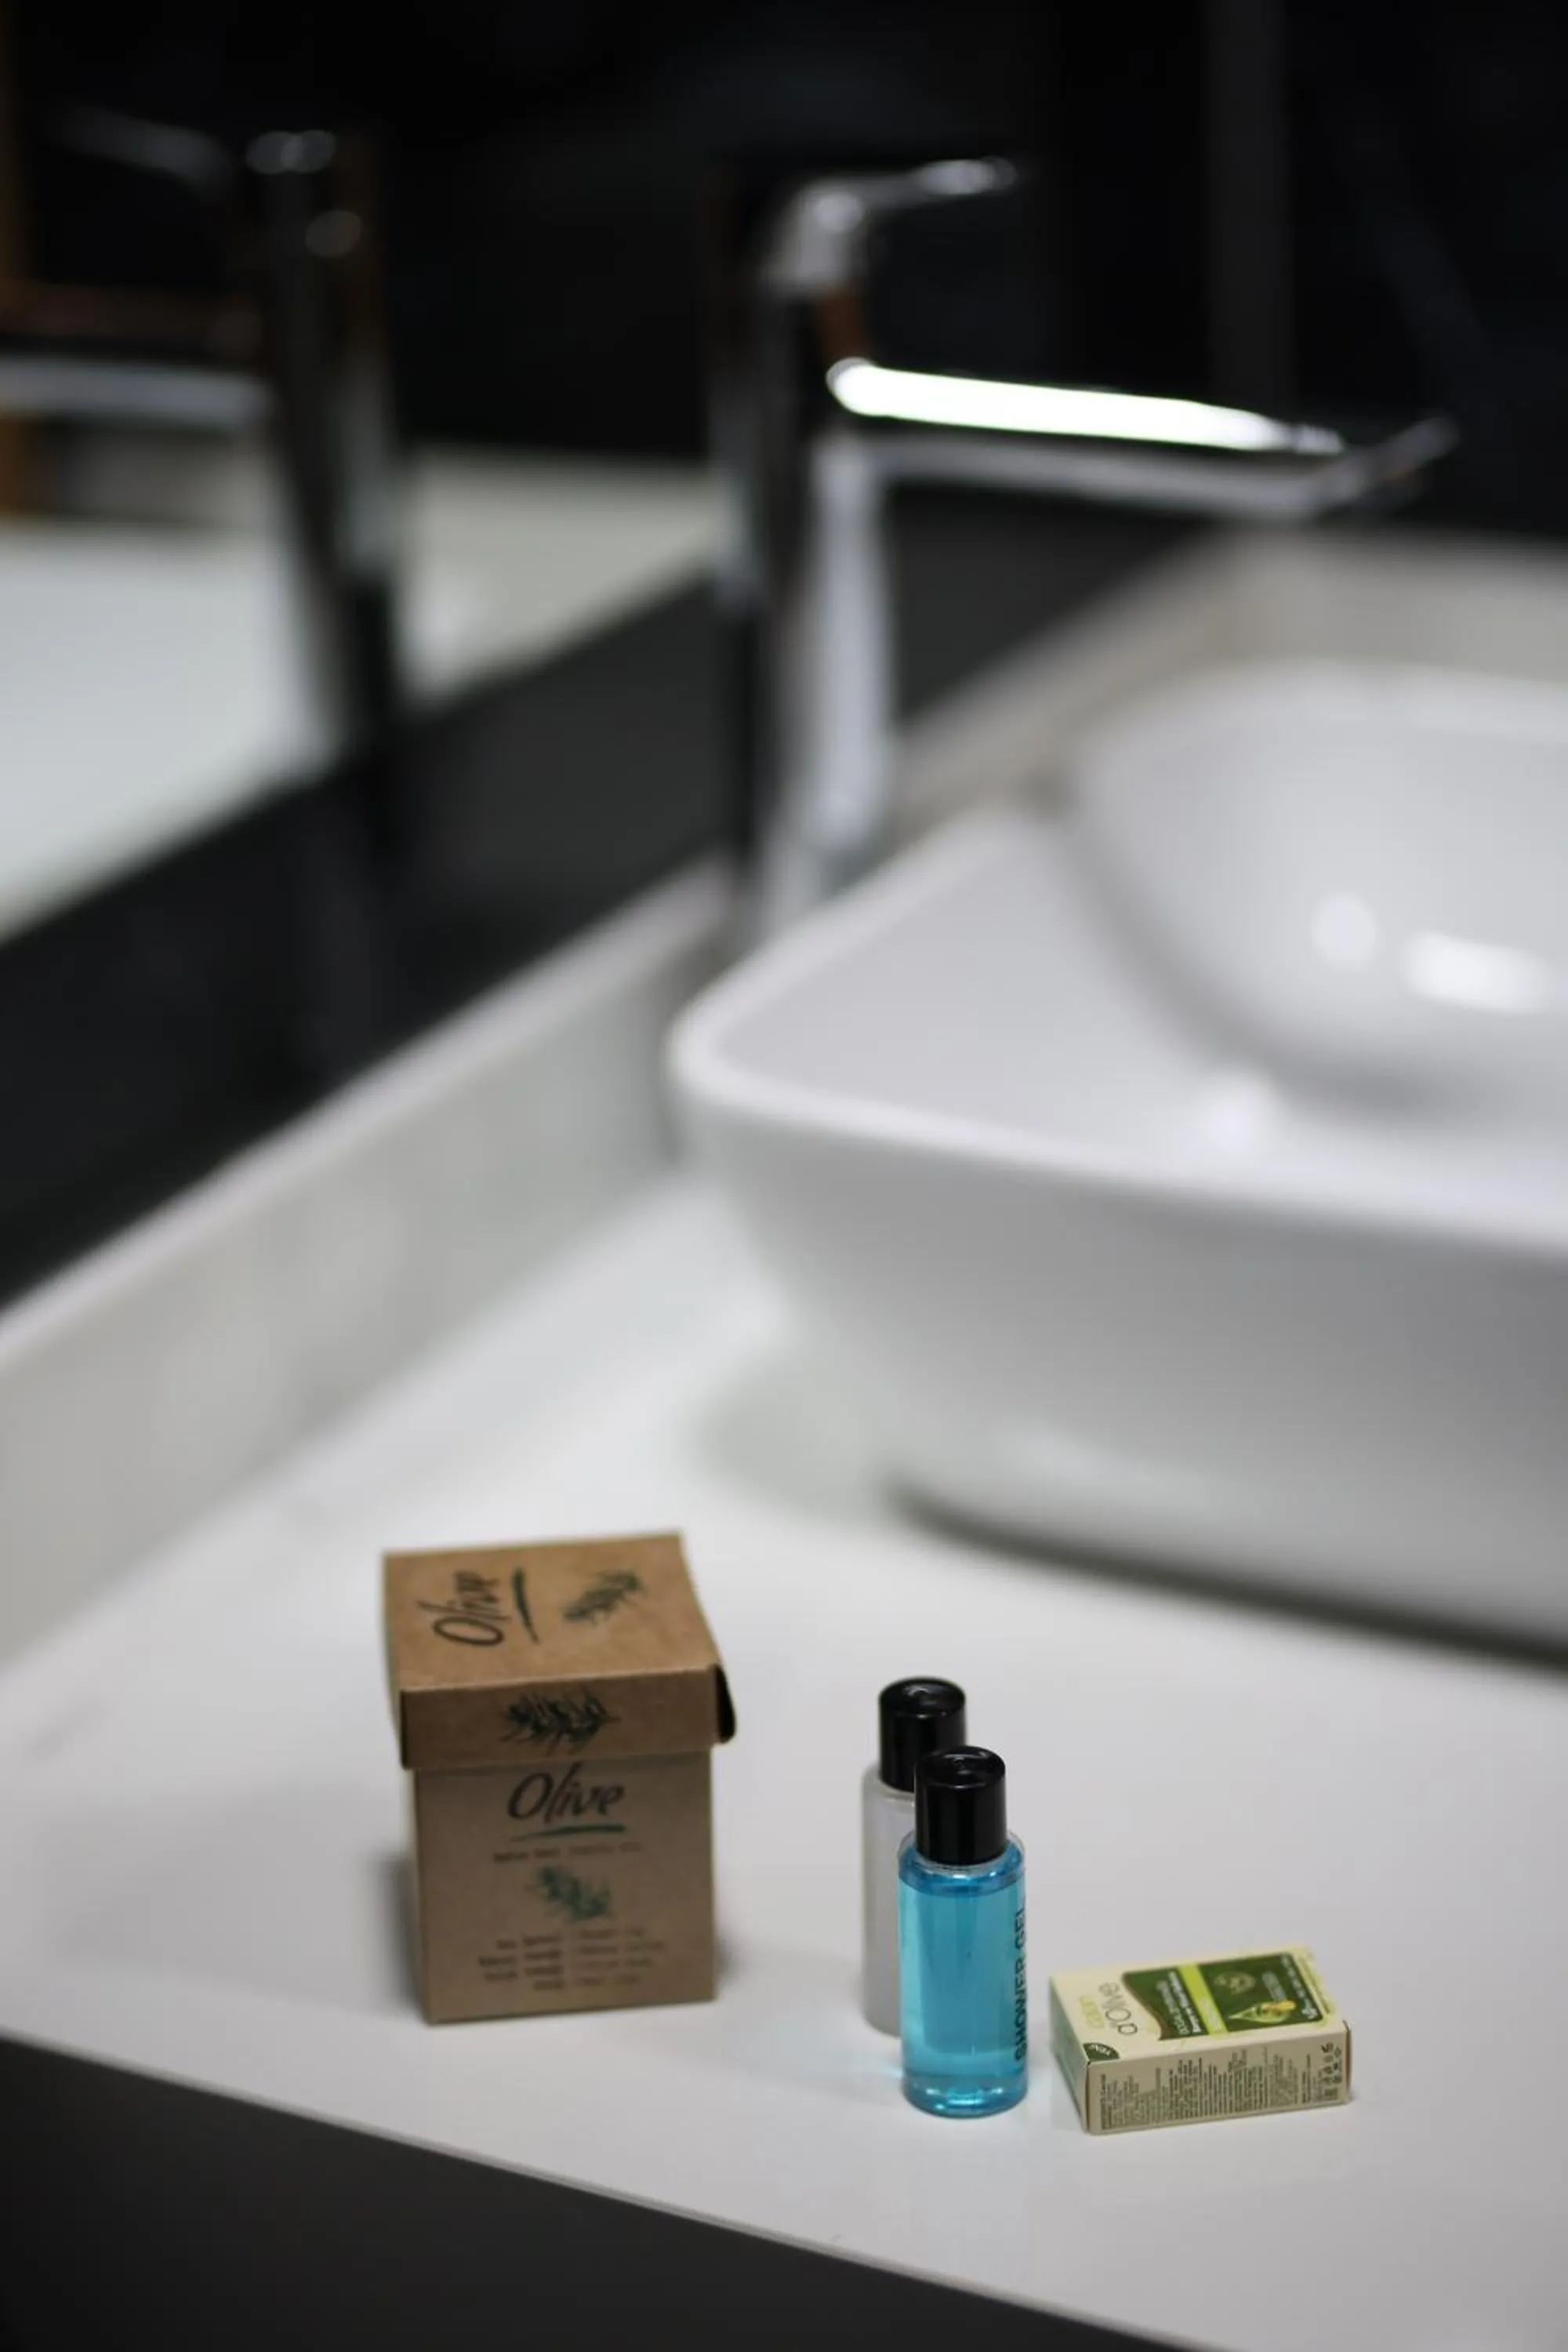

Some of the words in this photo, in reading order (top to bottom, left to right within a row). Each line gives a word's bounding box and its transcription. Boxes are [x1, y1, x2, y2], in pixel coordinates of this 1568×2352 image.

[507, 1762, 625, 1824] Olive
[1014, 1904, 1025, 1950] GEL
[1014, 1956, 1027, 2061] SHOWER
